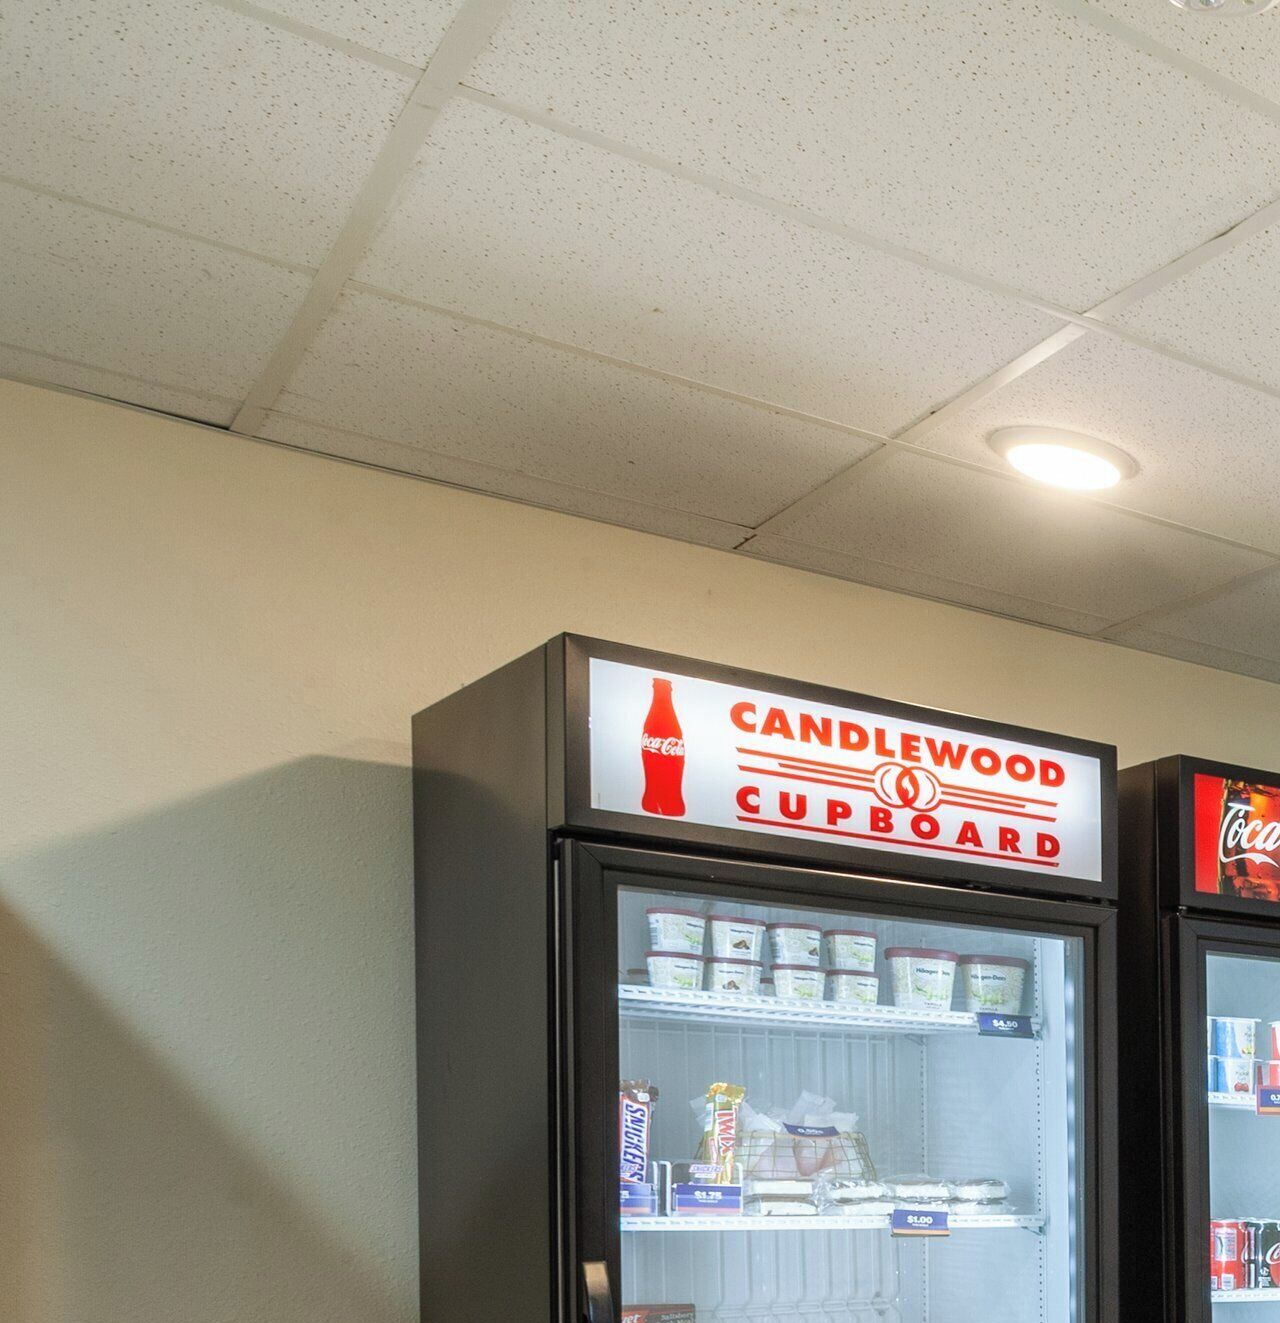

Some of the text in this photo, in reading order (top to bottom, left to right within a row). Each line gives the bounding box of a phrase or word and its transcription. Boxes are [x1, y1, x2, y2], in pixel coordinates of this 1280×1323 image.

[641, 731, 685, 757] Coca-Cola
[730, 701, 1065, 788] CANDLEWOOD
[736, 785, 1061, 859] CUPBOARD
[621, 1102, 646, 1183] SNICKERS
[714, 1108, 736, 1155] TWIX
[694, 1190, 723, 1201] $1.75
[907, 1215, 933, 1225] $1.00
